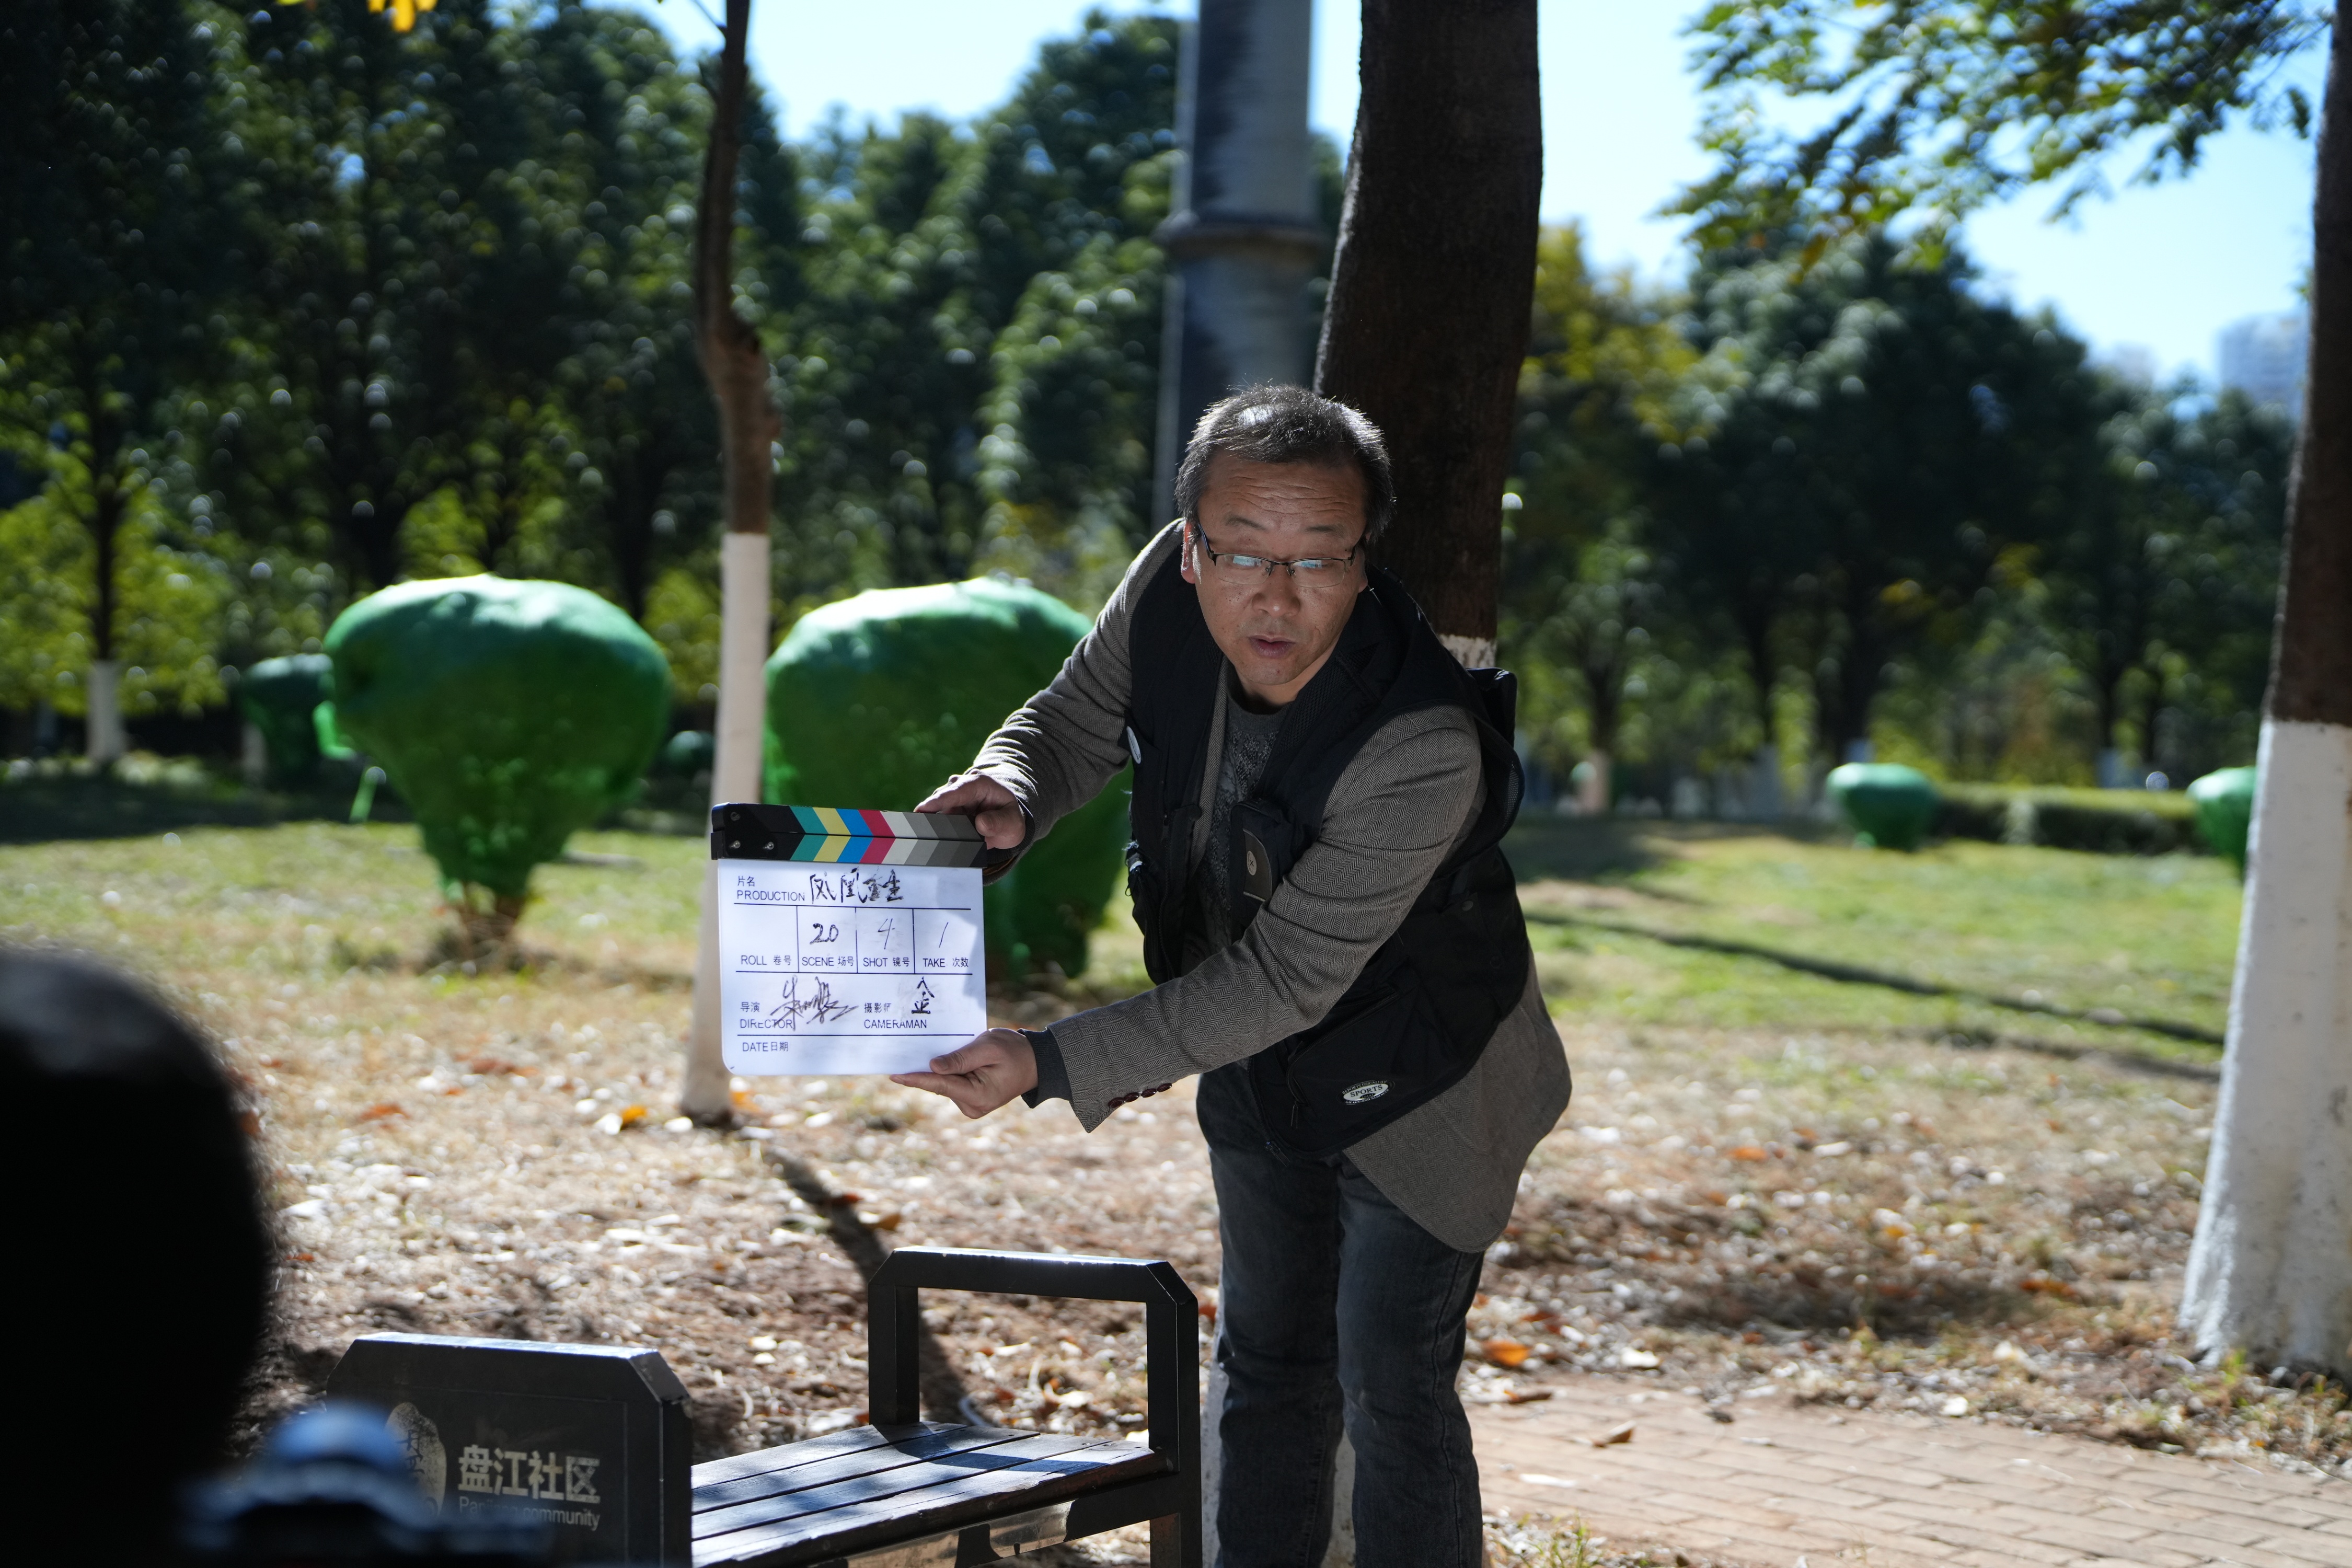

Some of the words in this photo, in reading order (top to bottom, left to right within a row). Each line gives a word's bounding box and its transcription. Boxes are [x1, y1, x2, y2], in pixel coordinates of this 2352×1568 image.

[737, 875, 755, 887] 片名
[736, 890, 805, 902] PRODUCTION
[810, 923, 839, 944] 20
[878, 918, 895, 950] 4
[741, 955, 767, 965] ROLL
[773, 954, 792, 966] 卷号
[802, 956, 835, 966] SCENE
[838, 956, 855, 966] 场号
[863, 957, 888, 967] SHOT
[893, 957, 910, 967] 镜号
[923, 958, 946, 967] TAKE
[952, 957, 969, 967] 次数
[740, 1001, 760, 1013] 导演
[864, 1002, 892, 1013] 摄影师
[740, 1019, 793, 1029] DIRECTOR
[863, 1019, 927, 1029] CAMERAMAN
[742, 1042, 769, 1052] DATE
[770, 1041, 789, 1052] 日期
[1350, 1085, 1383, 1097] SPORTS
[457, 1444, 601, 1504] 盘江社区
[522, 1506, 601, 1531] community
